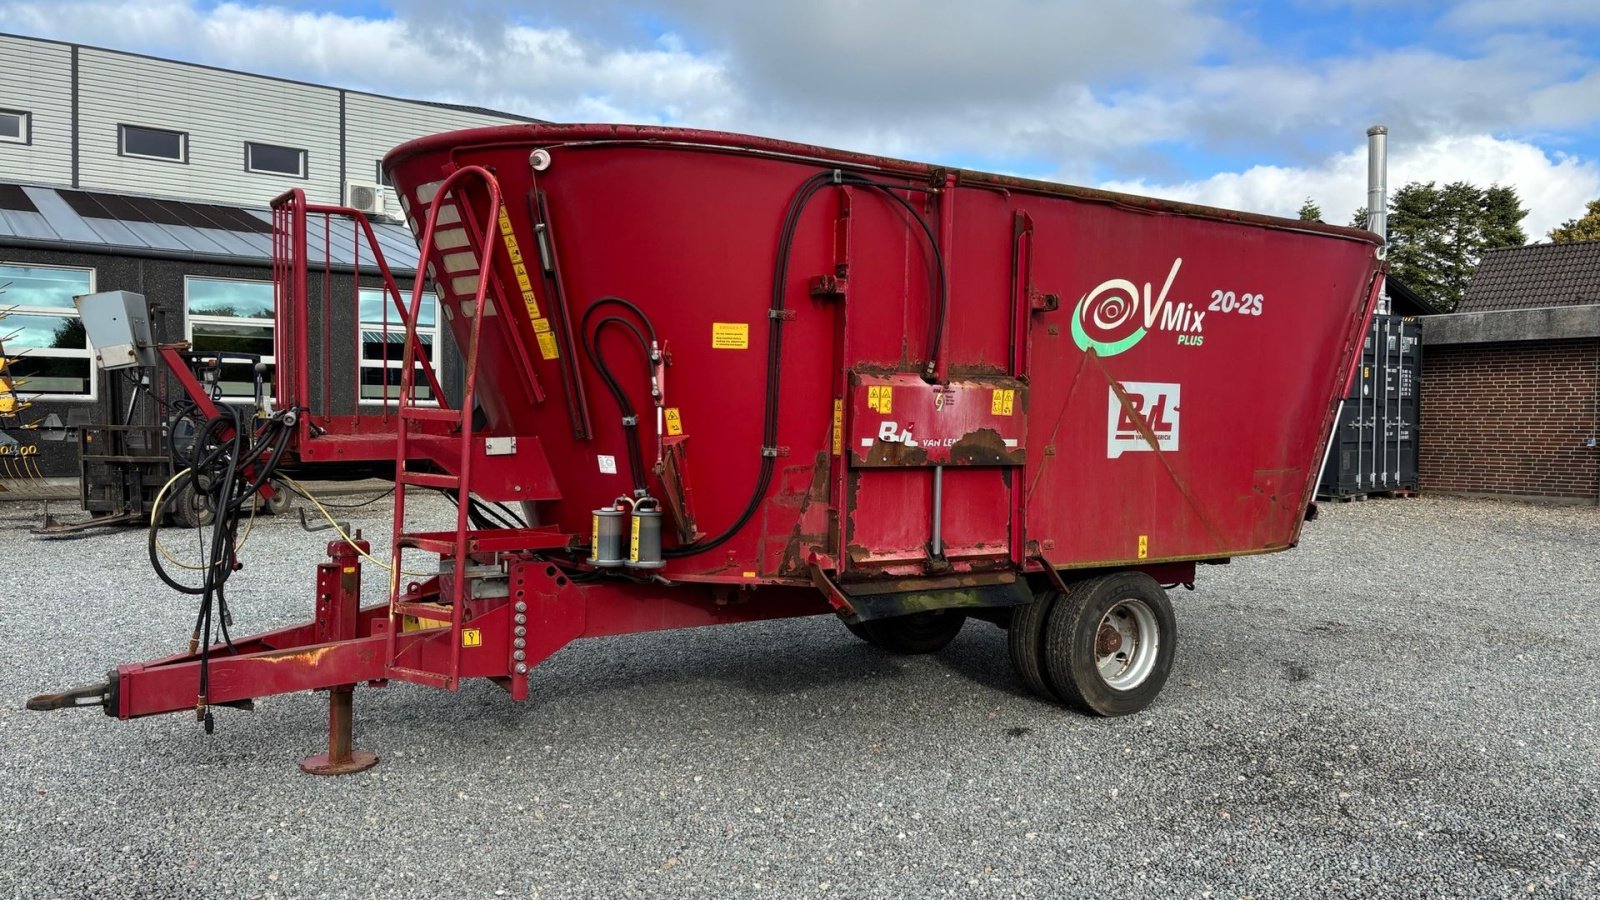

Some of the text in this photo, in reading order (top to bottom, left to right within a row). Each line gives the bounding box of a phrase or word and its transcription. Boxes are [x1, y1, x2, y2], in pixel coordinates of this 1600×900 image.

[1208, 290, 1264, 316] 20-2S
[1177, 334, 1204, 346] PLUS
[923, 439, 941, 447] VAN
